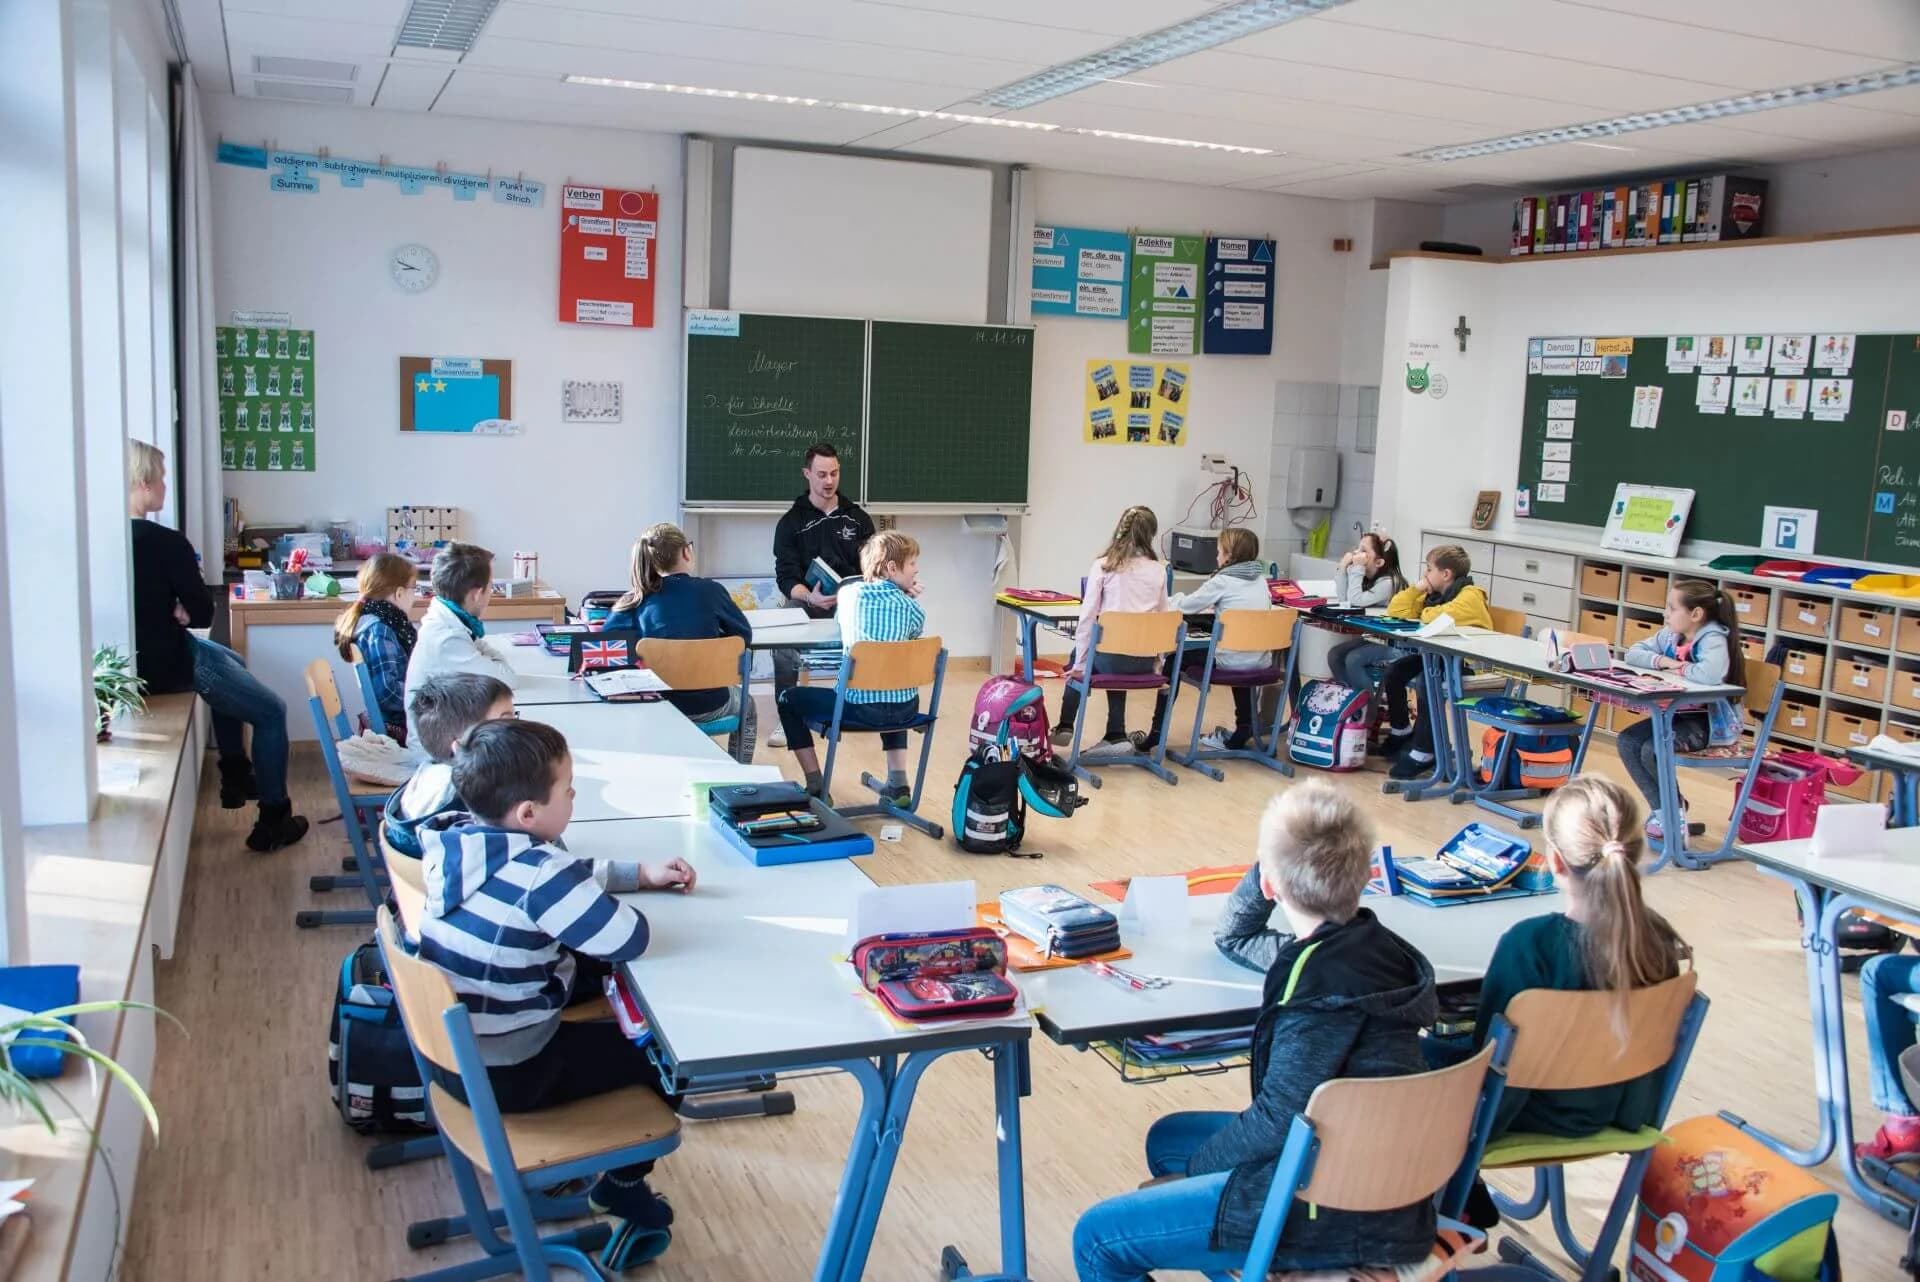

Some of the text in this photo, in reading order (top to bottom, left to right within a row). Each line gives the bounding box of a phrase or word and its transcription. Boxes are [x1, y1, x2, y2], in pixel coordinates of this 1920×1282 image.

[274, 155, 318, 169] addieren
[324, 161, 381, 176] subtrahieren
[385, 169, 440, 184] multiplizieren
[444, 175, 489, 190] dividieren
[277, 178, 314, 191] Summe
[500, 181, 539, 194] Punkt vor
[506, 193, 531, 204] Strich
[567, 189, 601, 200] Verben
[1033, 230, 1053, 239] rtikel
[1137, 238, 1173, 248] Adjektive
[1220, 241, 1247, 250] Nomen
[1546, 342, 1575, 353] Dienstag
[1583, 342, 1593, 353] 13.
[1596, 344, 1620, 353] Herbst
[1580, 360, 1600, 371] 2017
[1891, 414, 1901, 427] D
[1879, 497, 1890, 507] M
[1778, 521, 1796, 545] P
